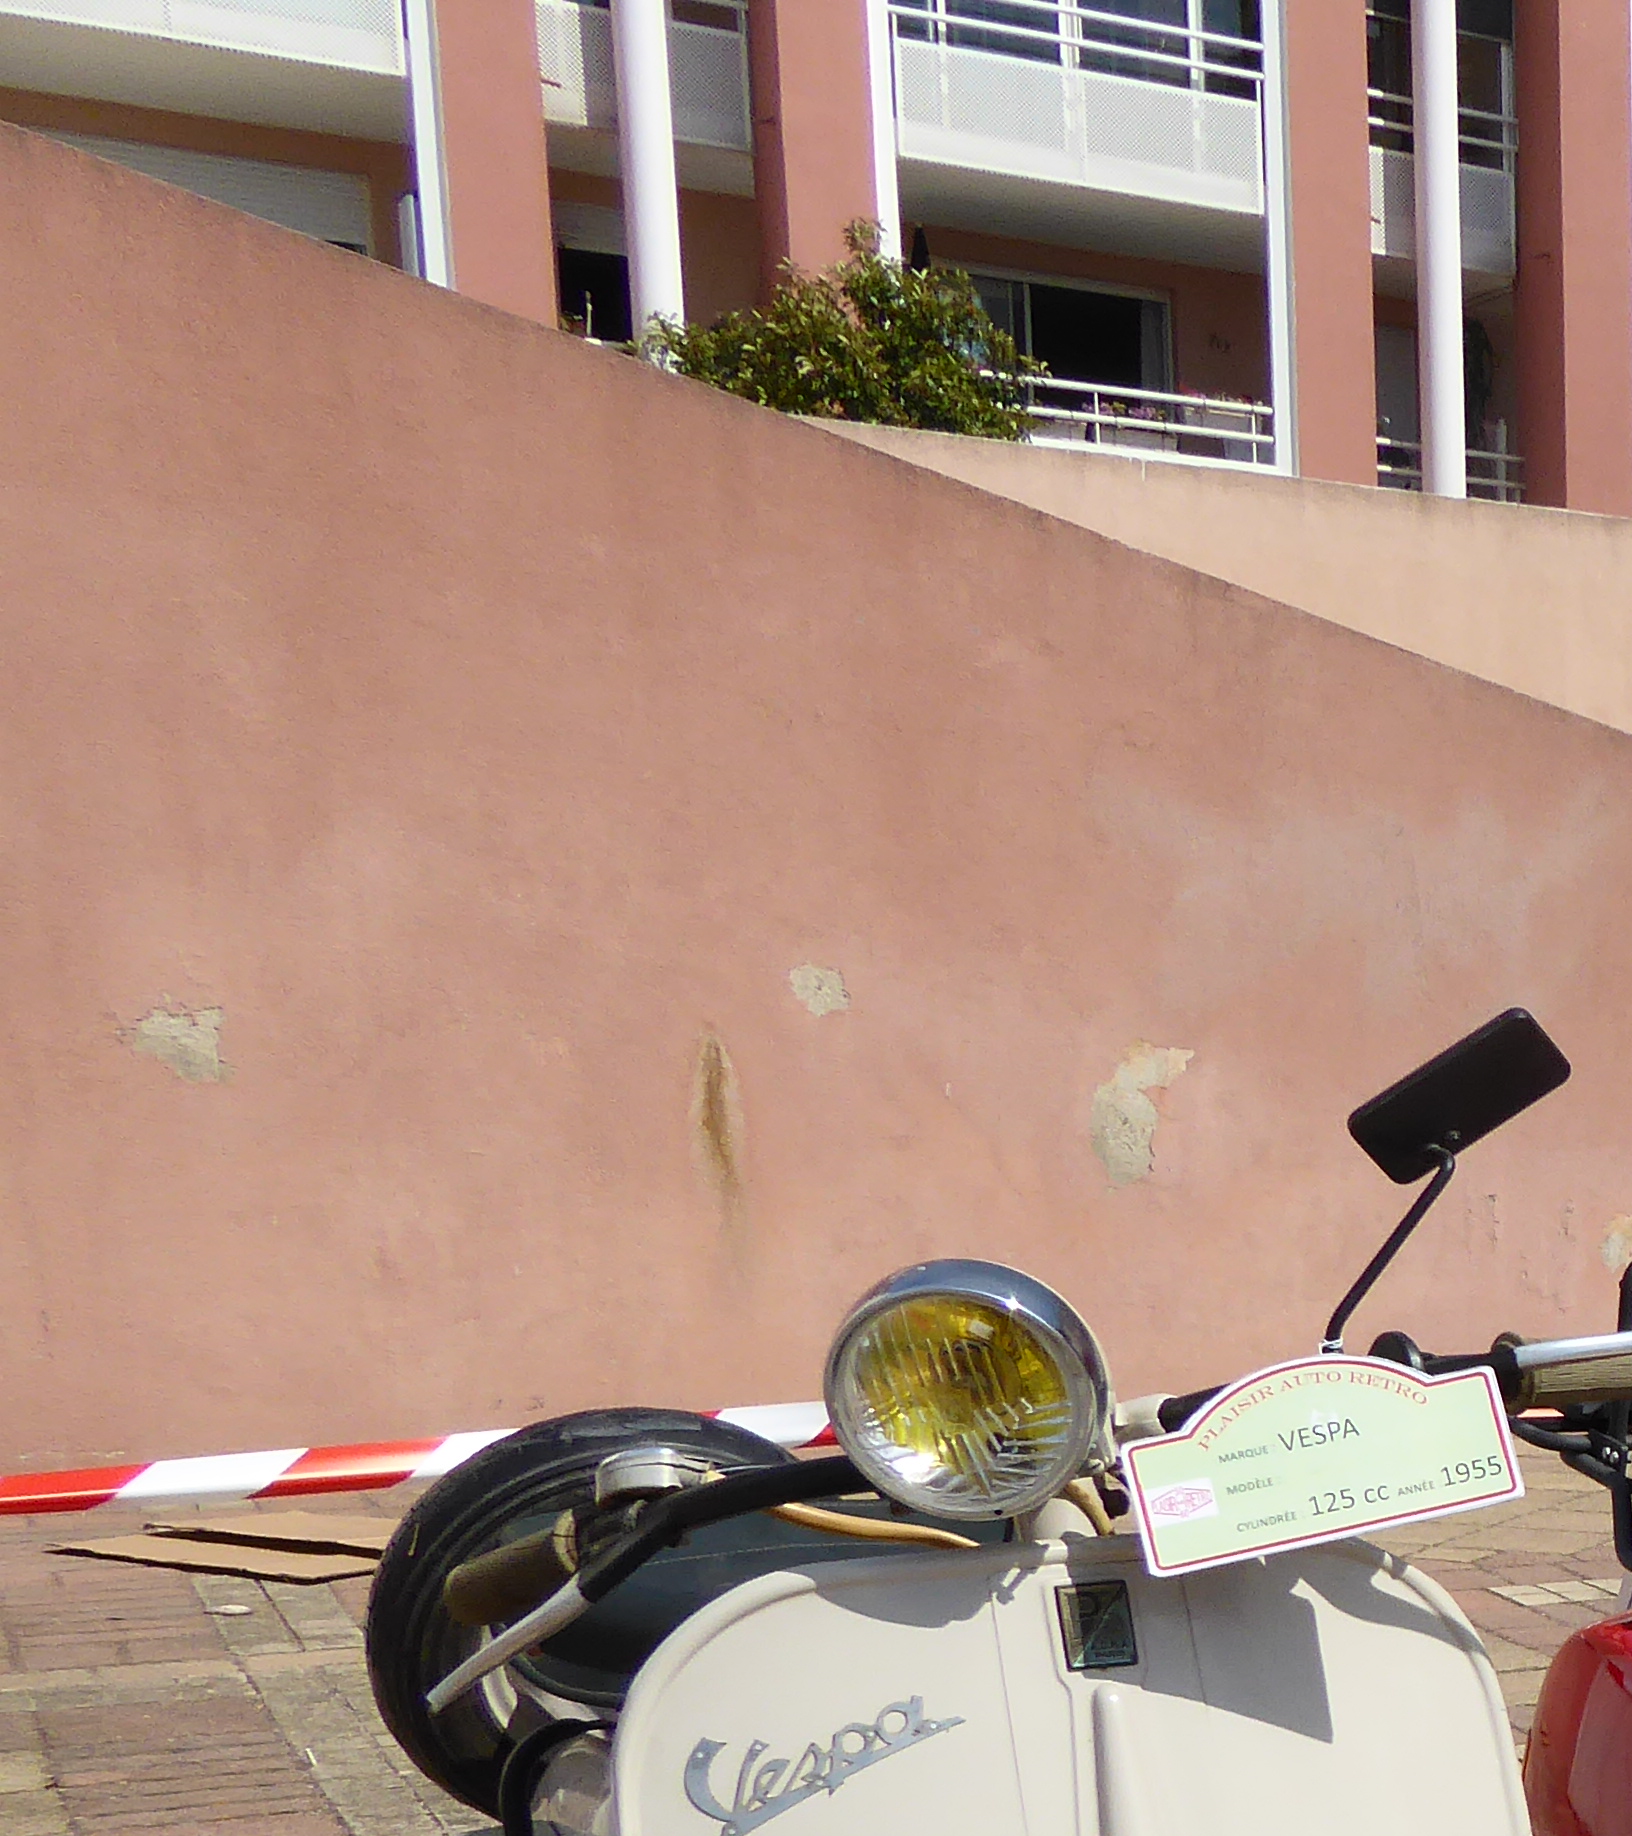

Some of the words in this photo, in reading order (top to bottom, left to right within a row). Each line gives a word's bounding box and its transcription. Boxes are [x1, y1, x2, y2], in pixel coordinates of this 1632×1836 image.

[1198, 1385, 1274, 1451] PLAISIR
[1279, 1371, 1342, 1393] AUTO
[1349, 1371, 1429, 1405] RETRO
[1218, 1446, 1269, 1464] MARQUE
[1277, 1418, 1361, 1452] VESPA
[1226, 1476, 1274, 1496] MODÈLE
[1236, 1510, 1298, 1533] CYLINDRÉE
[1308, 1488, 1356, 1517] 125
[1397, 1480, 1435, 1497] ANNÉE
[1440, 1455, 1503, 1488] 1955
